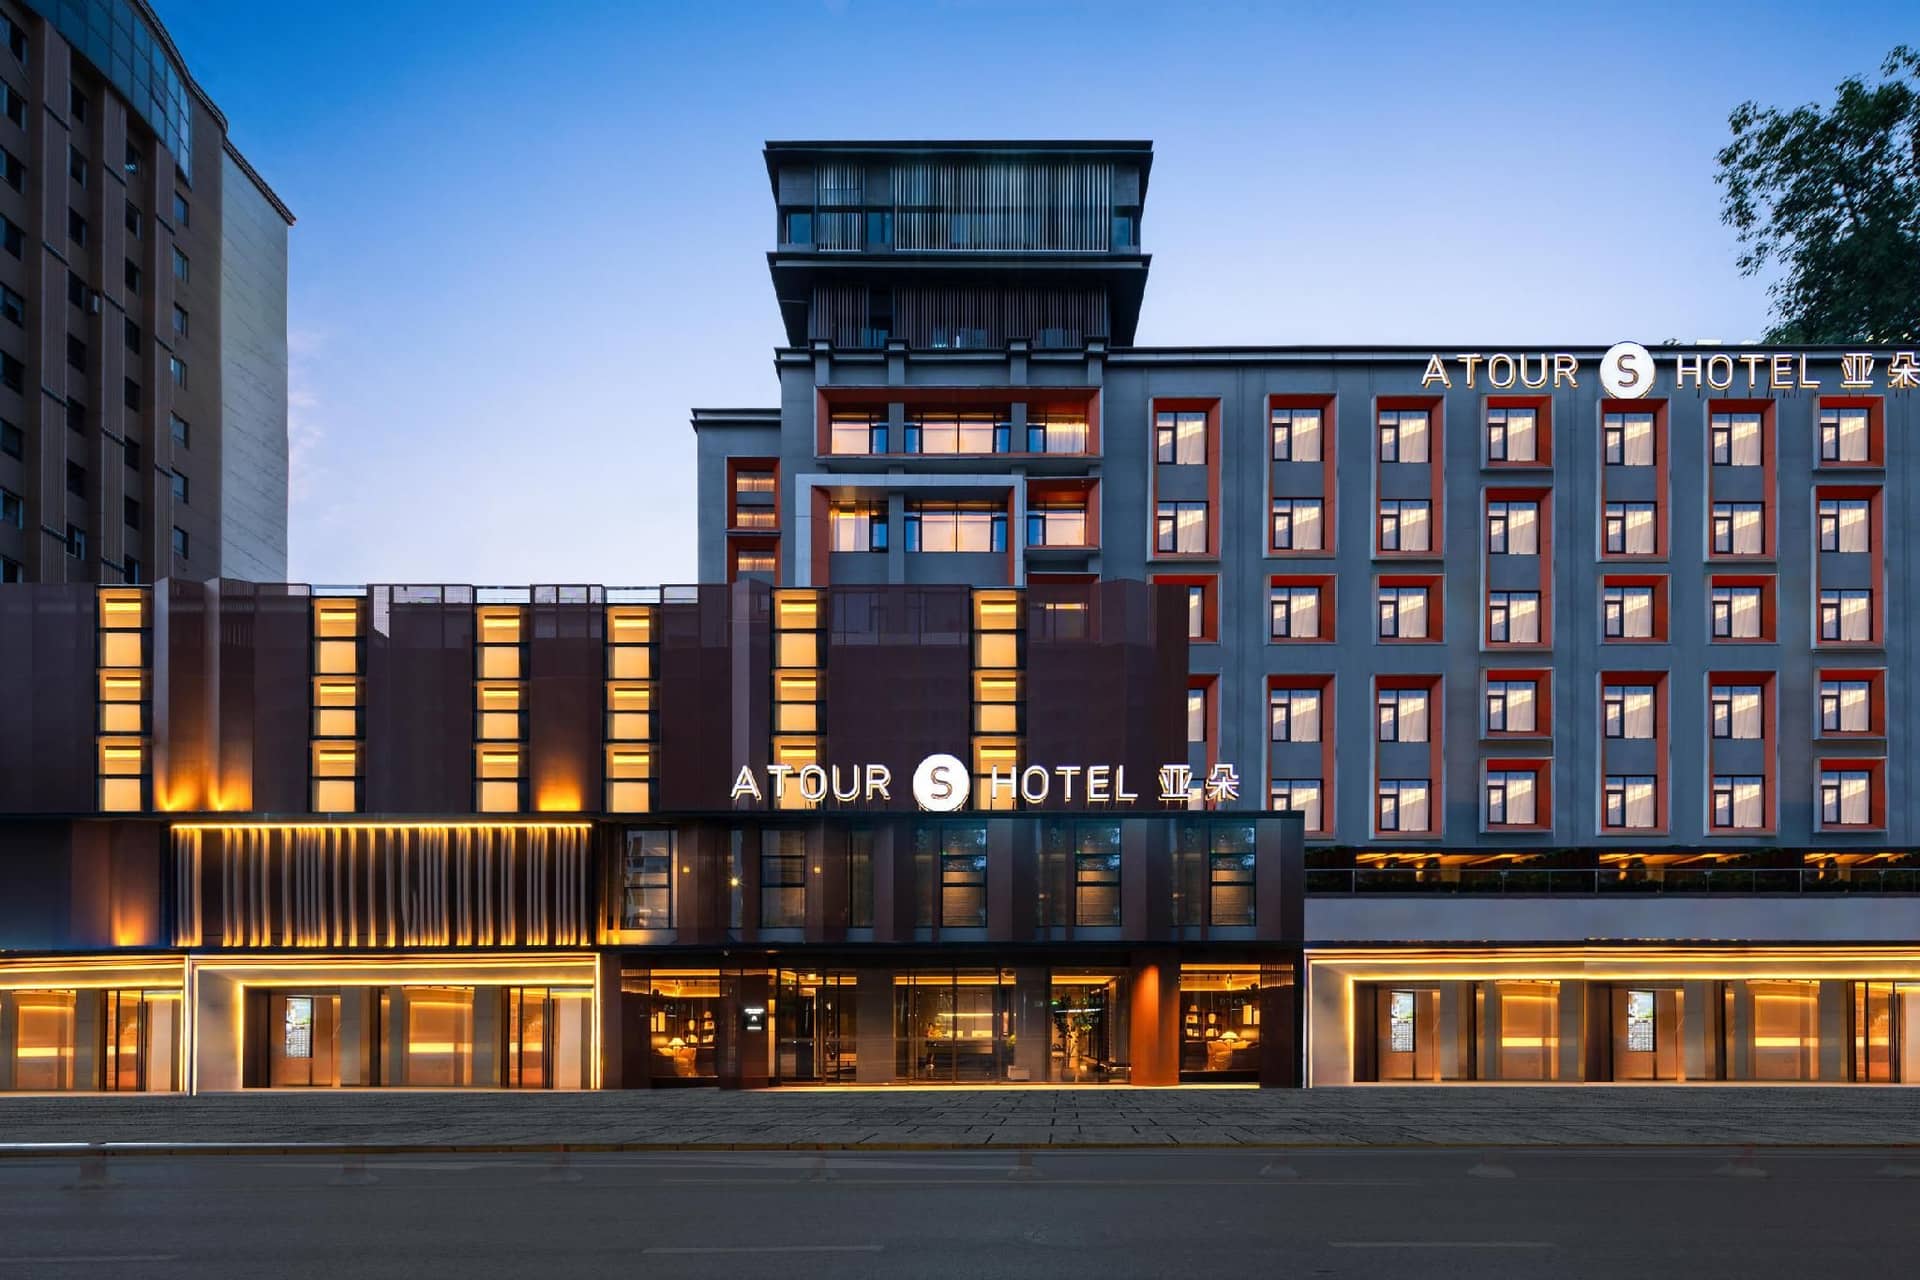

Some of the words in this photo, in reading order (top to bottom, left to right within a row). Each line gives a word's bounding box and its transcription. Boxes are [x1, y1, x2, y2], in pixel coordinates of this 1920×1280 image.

[1421, 353, 1579, 388] ATOUR
[1676, 353, 1822, 390] HOTEL
[1840, 351, 1920, 389] 亚朵
[730, 764, 891, 802] ATOUR
[991, 765, 1139, 803] HOTEL
[1158, 763, 1240, 802] 亚朵
